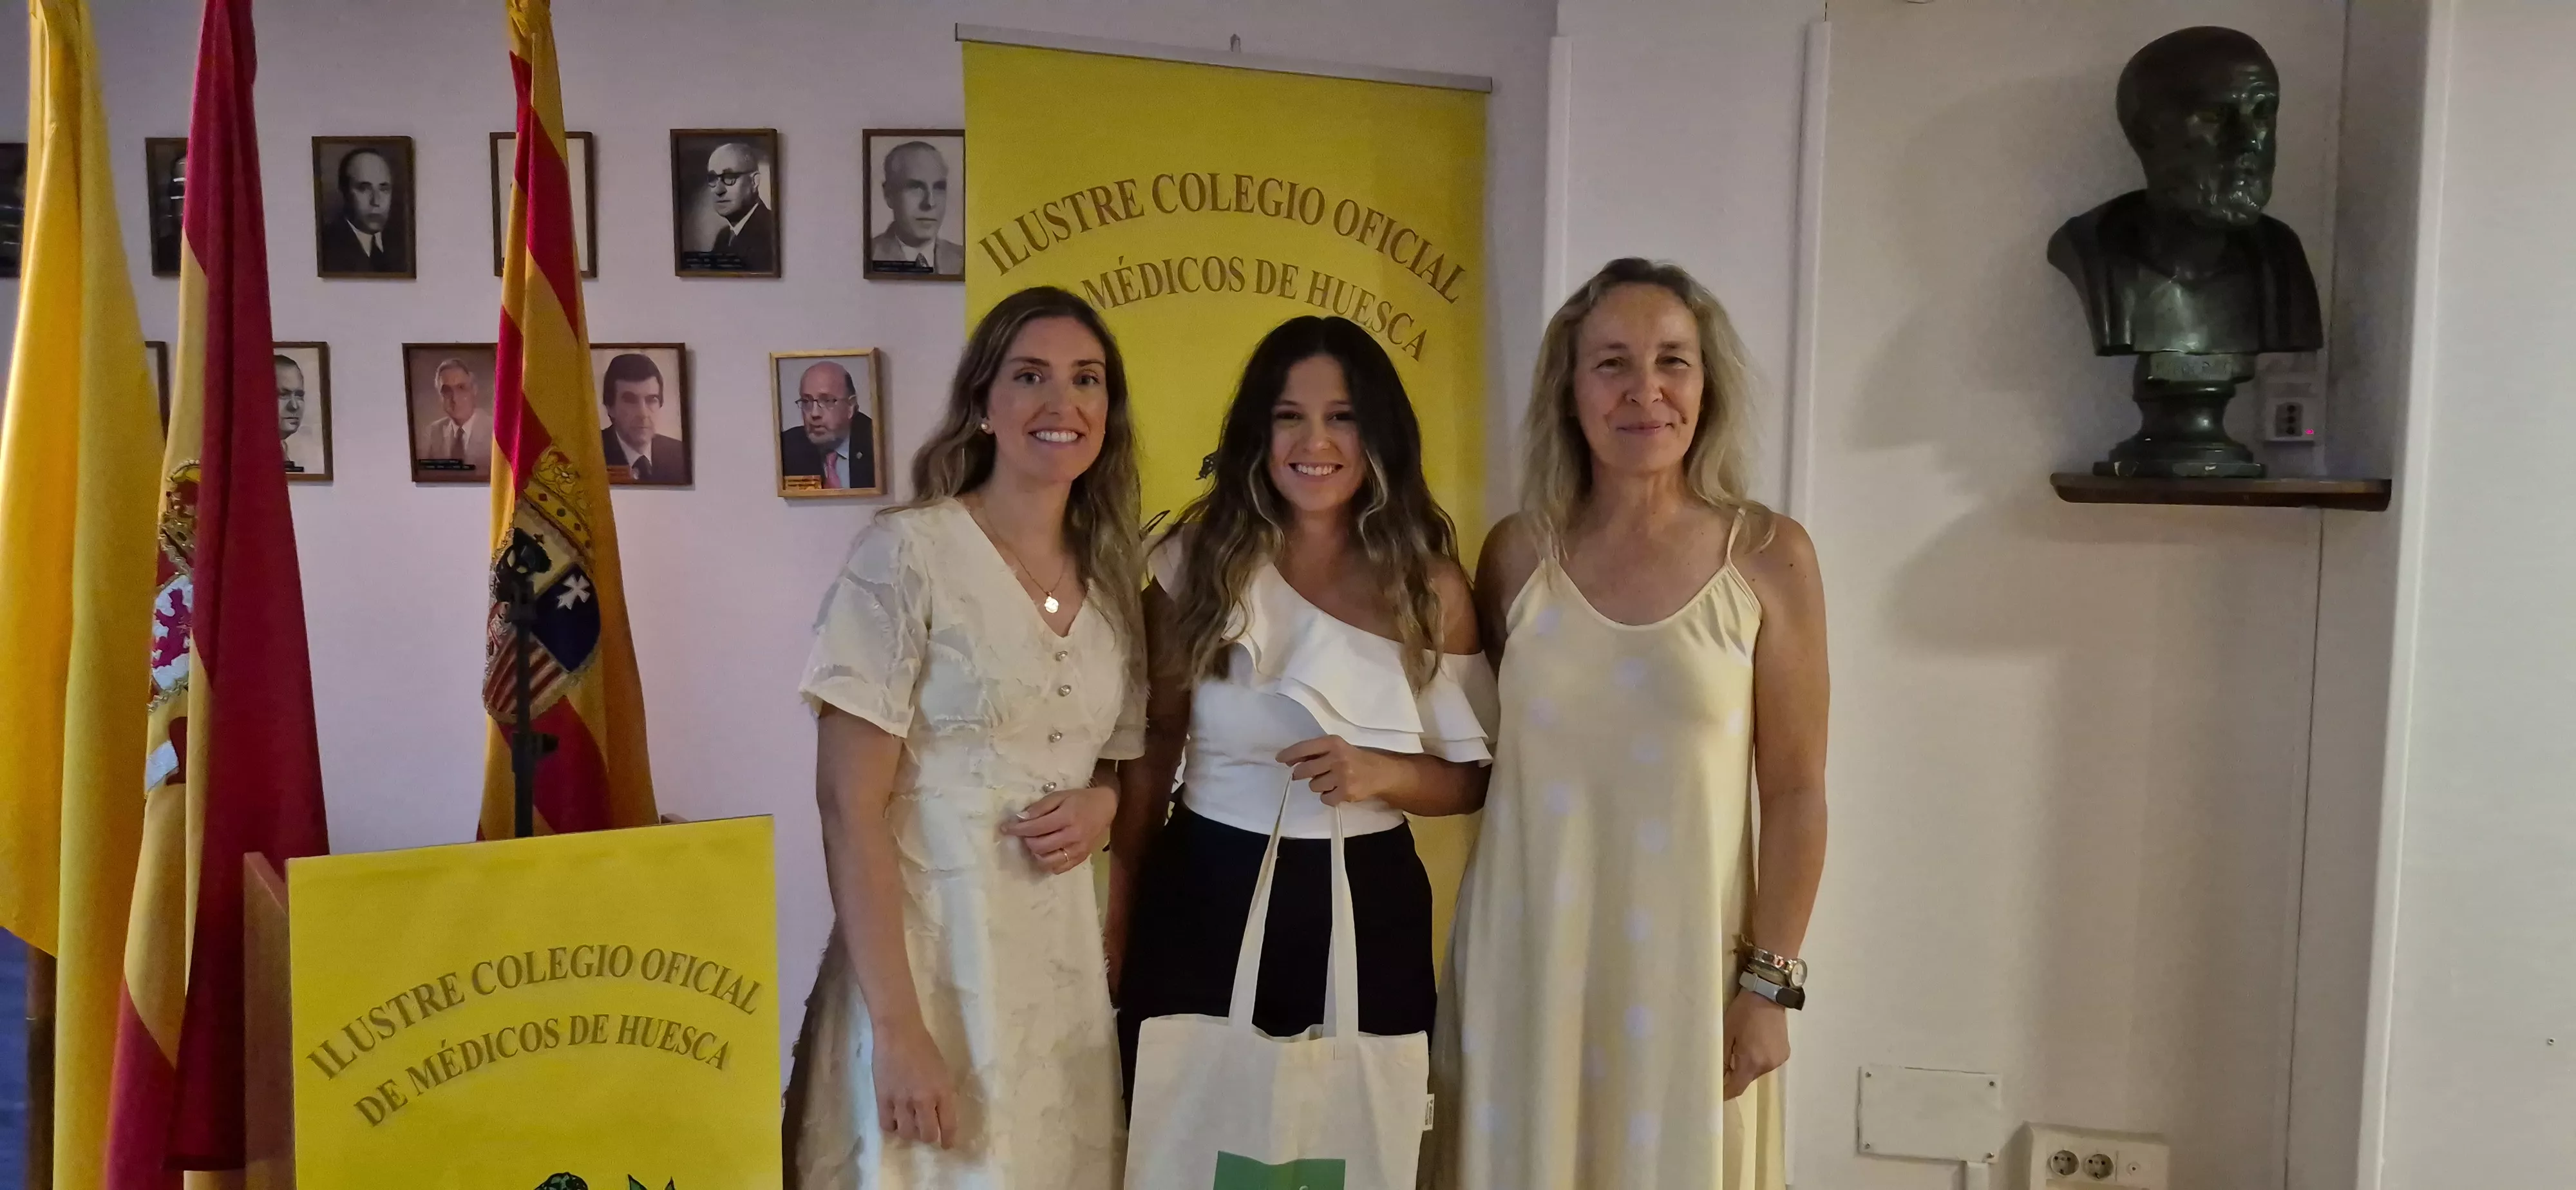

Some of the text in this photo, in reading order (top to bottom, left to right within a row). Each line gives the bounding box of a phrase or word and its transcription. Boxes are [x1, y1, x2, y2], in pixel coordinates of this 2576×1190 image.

[979, 173, 1465, 304] ILUSTRE COLEGIO OFICIAL
[1080, 256, 1427, 362] MÉDICOS DE HUESCA
[307, 945, 762, 1080] ILUSTRE COLEGIO OFICIAL
[354, 1014, 730, 1127] DE MÉDICOS DE HUESCA
